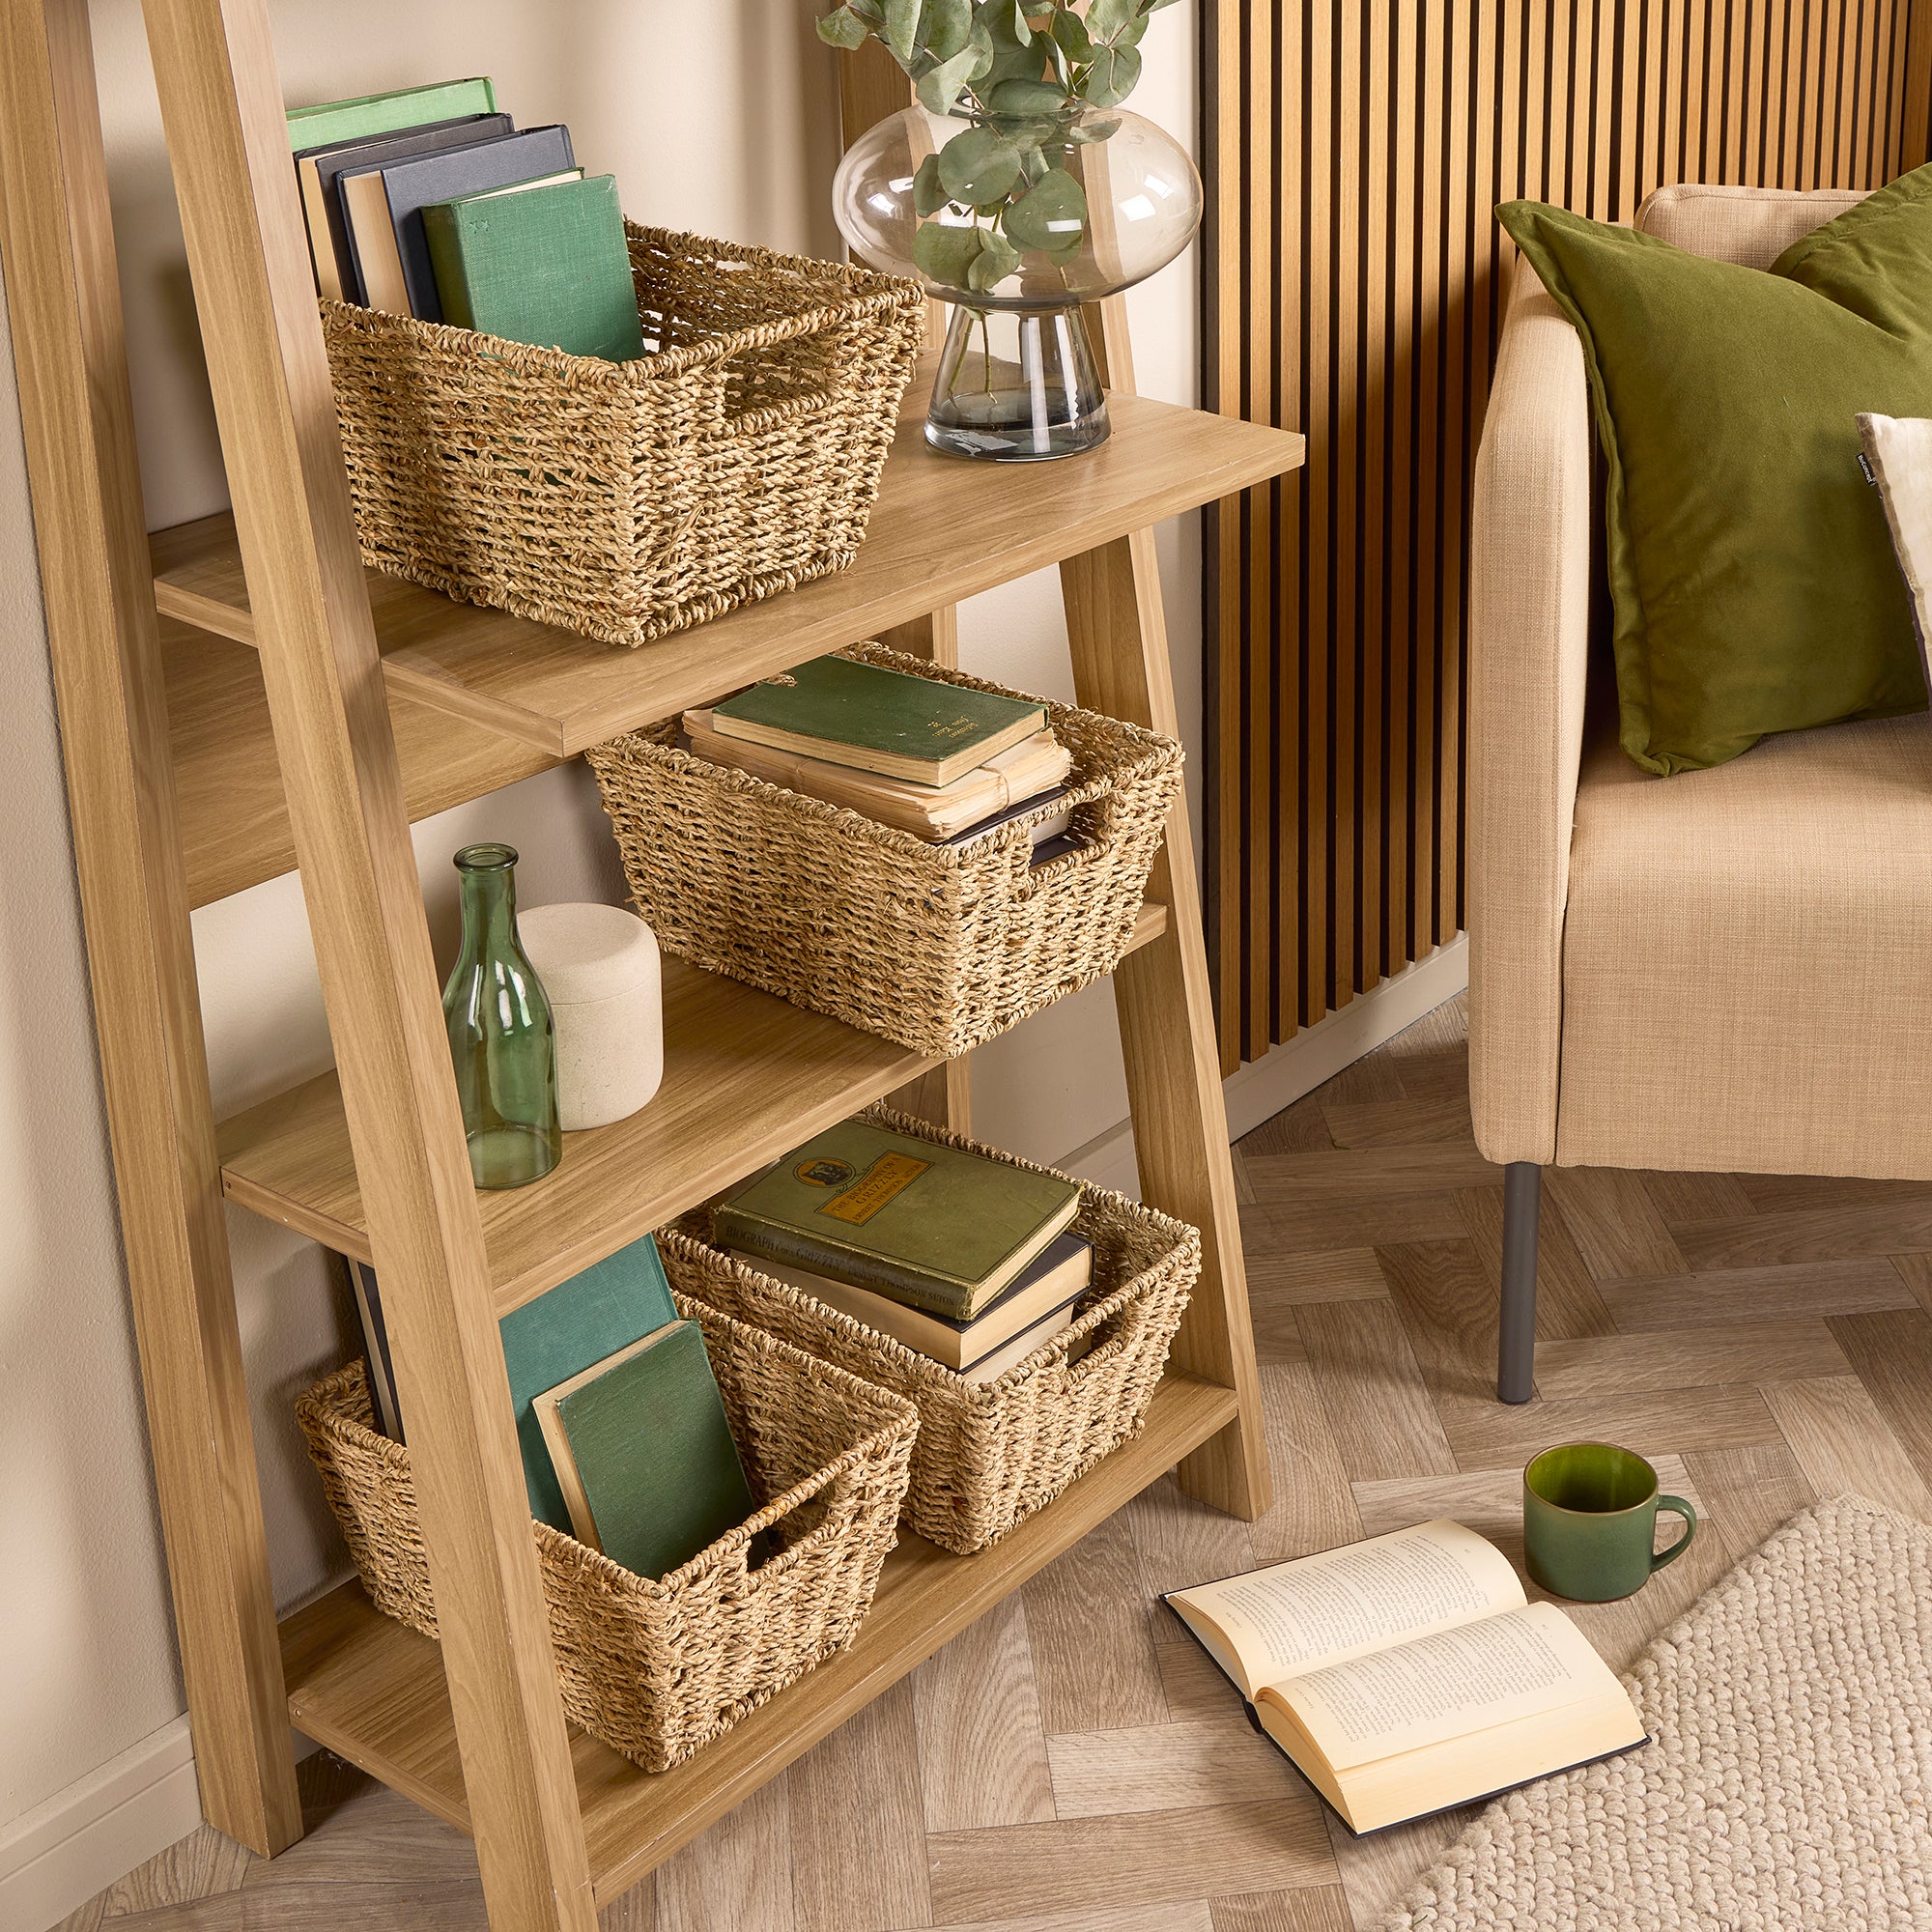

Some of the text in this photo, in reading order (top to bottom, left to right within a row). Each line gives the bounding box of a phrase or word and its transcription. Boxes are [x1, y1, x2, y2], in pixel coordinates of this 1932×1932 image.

[832, 1200, 848, 1211] THE
[847, 1169, 887, 1200] BIOGRAPHY
[856, 1170, 898, 1204] GRIZZLY
[725, 1225, 780, 1252] BIOGRAPHY
[796, 1247, 843, 1271] GRIZZLY
[880, 1277, 926, 1297] THOMPSON
[927, 1291, 955, 1306] SETON
